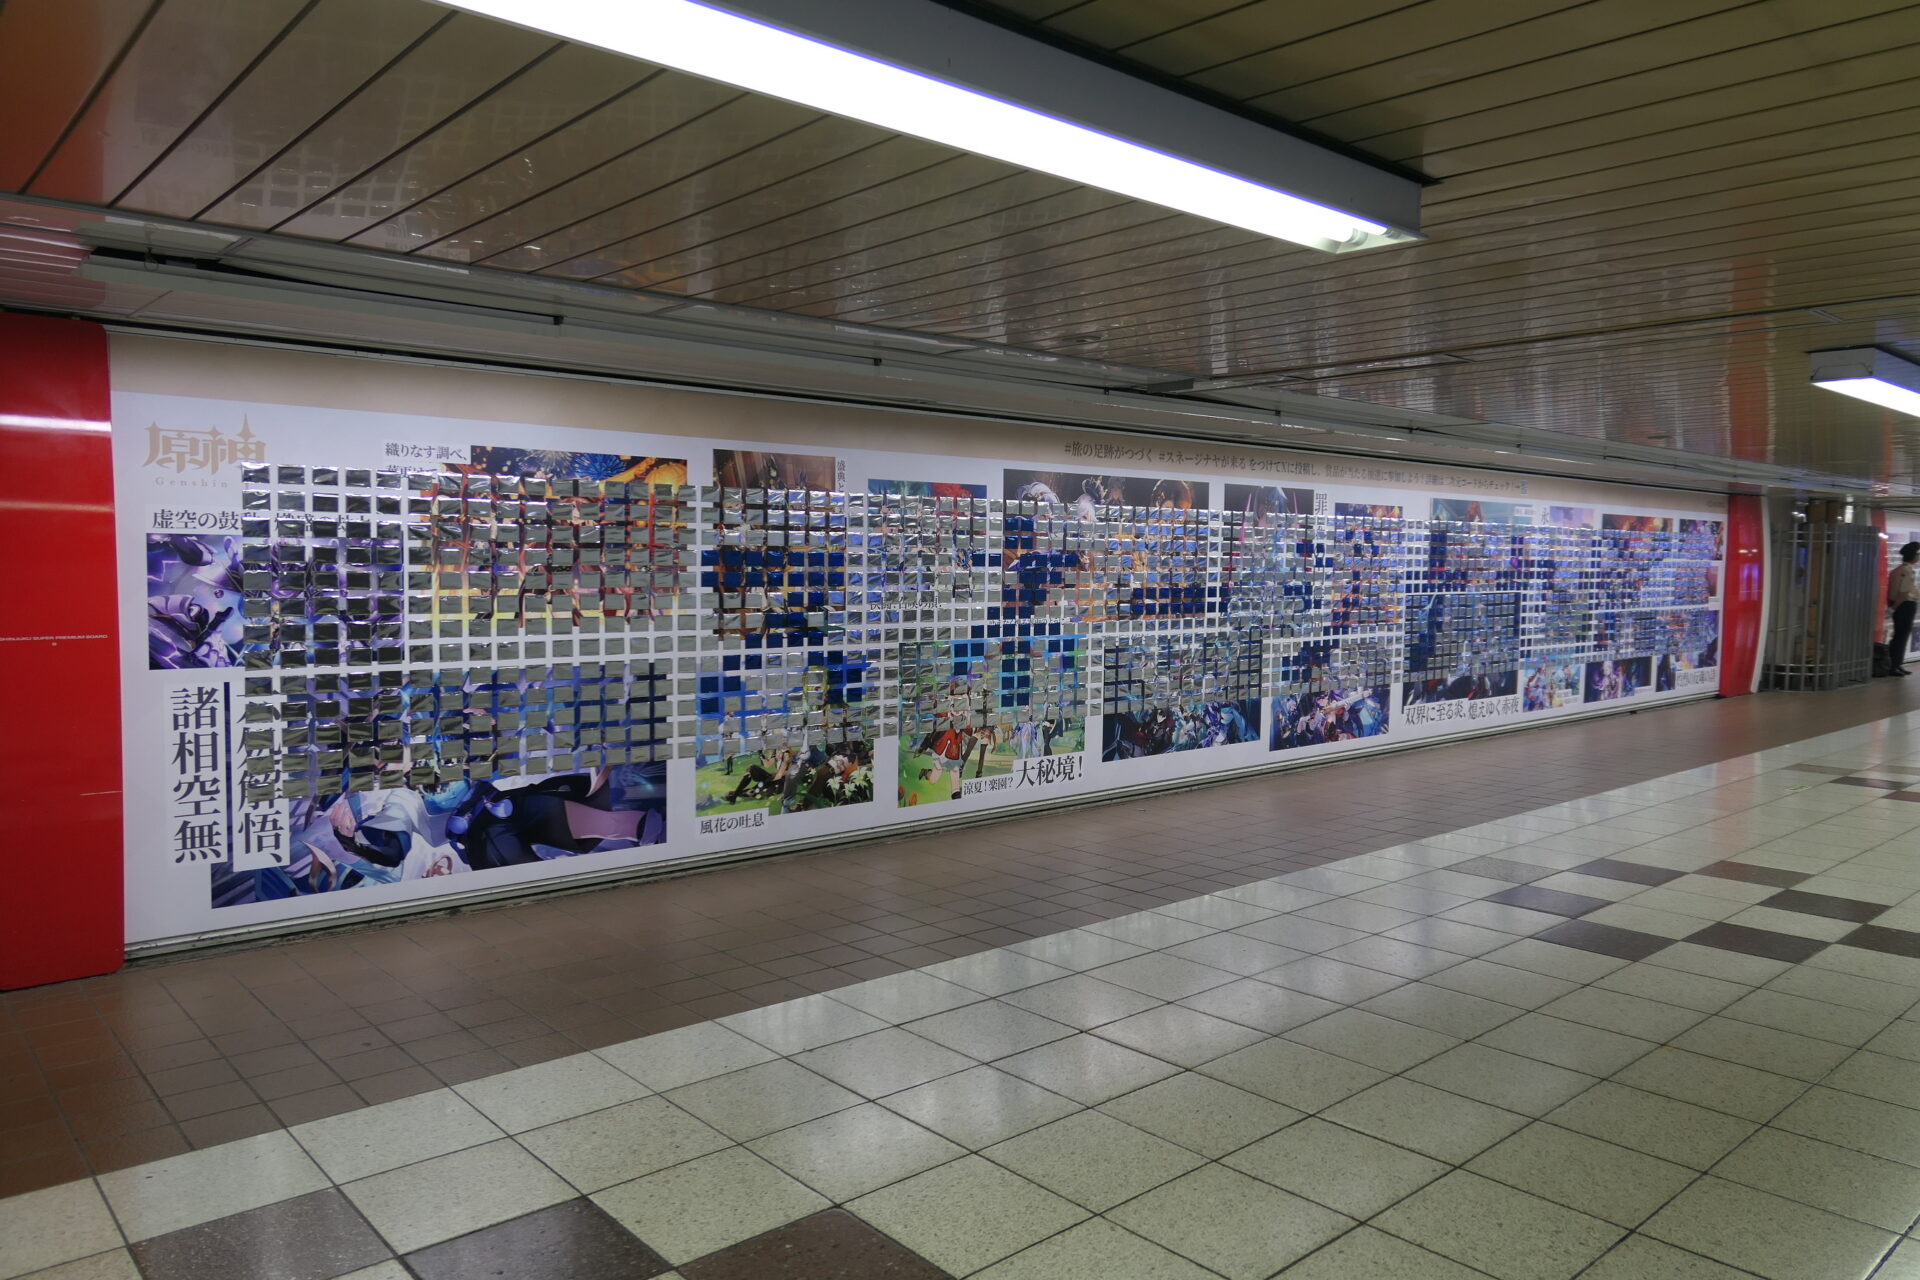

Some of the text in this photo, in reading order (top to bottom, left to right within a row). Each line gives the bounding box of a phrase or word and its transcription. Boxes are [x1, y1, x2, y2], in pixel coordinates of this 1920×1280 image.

[143, 412, 266, 475] 原神
[385, 442, 467, 461] 織りなす調べ、
[155, 476, 228, 488] Genshin
[171, 686, 222, 865] 諸相空無
[1015, 755, 1084, 789] 大秘境!
[700, 812, 765, 835] 風花の吐息
